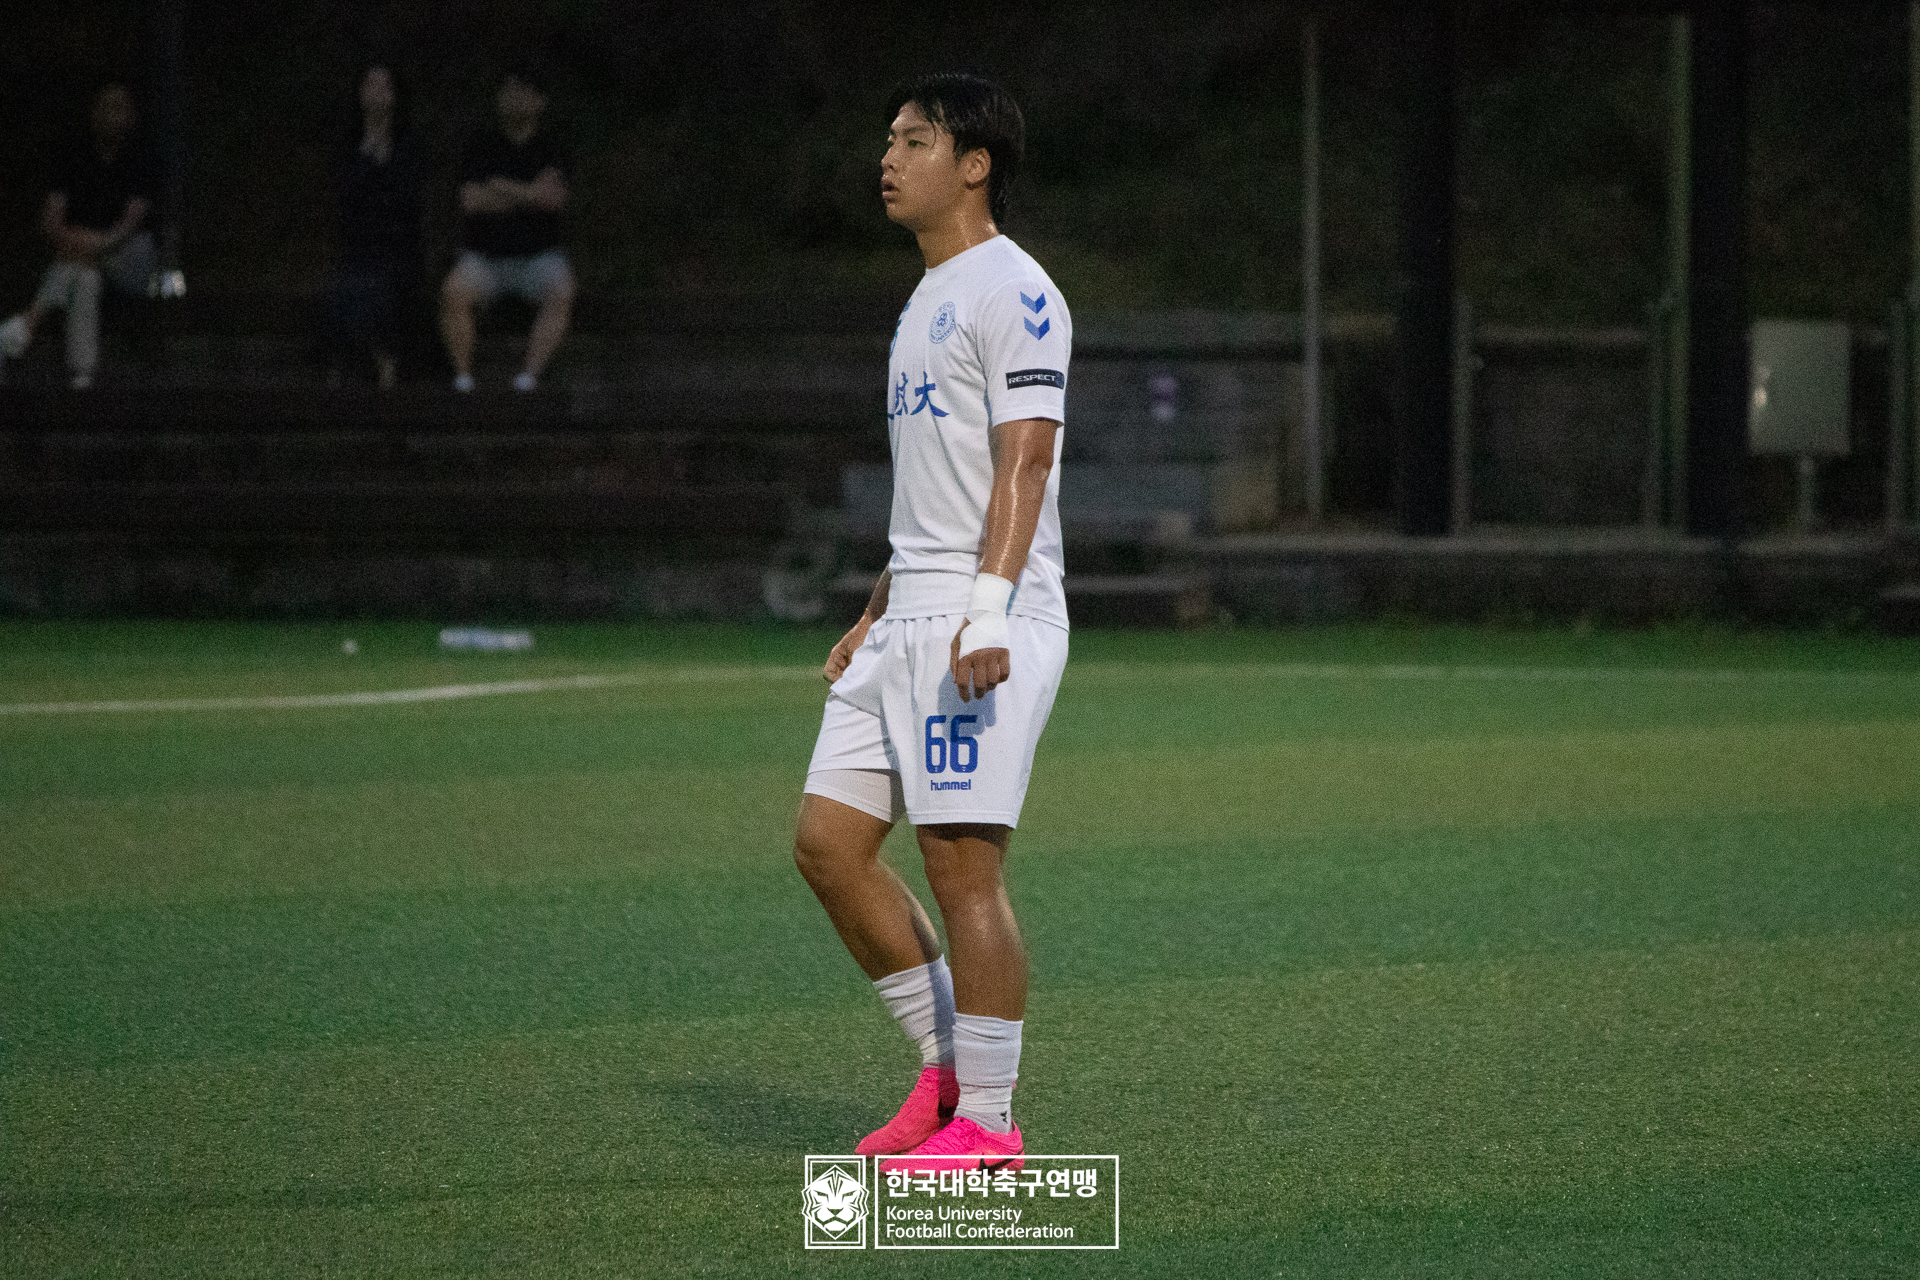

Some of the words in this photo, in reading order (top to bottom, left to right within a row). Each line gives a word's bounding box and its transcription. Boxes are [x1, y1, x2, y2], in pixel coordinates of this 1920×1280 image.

[1008, 374, 1056, 384] RESPECT
[925, 714, 978, 773] 66
[931, 778, 971, 791] hummel
